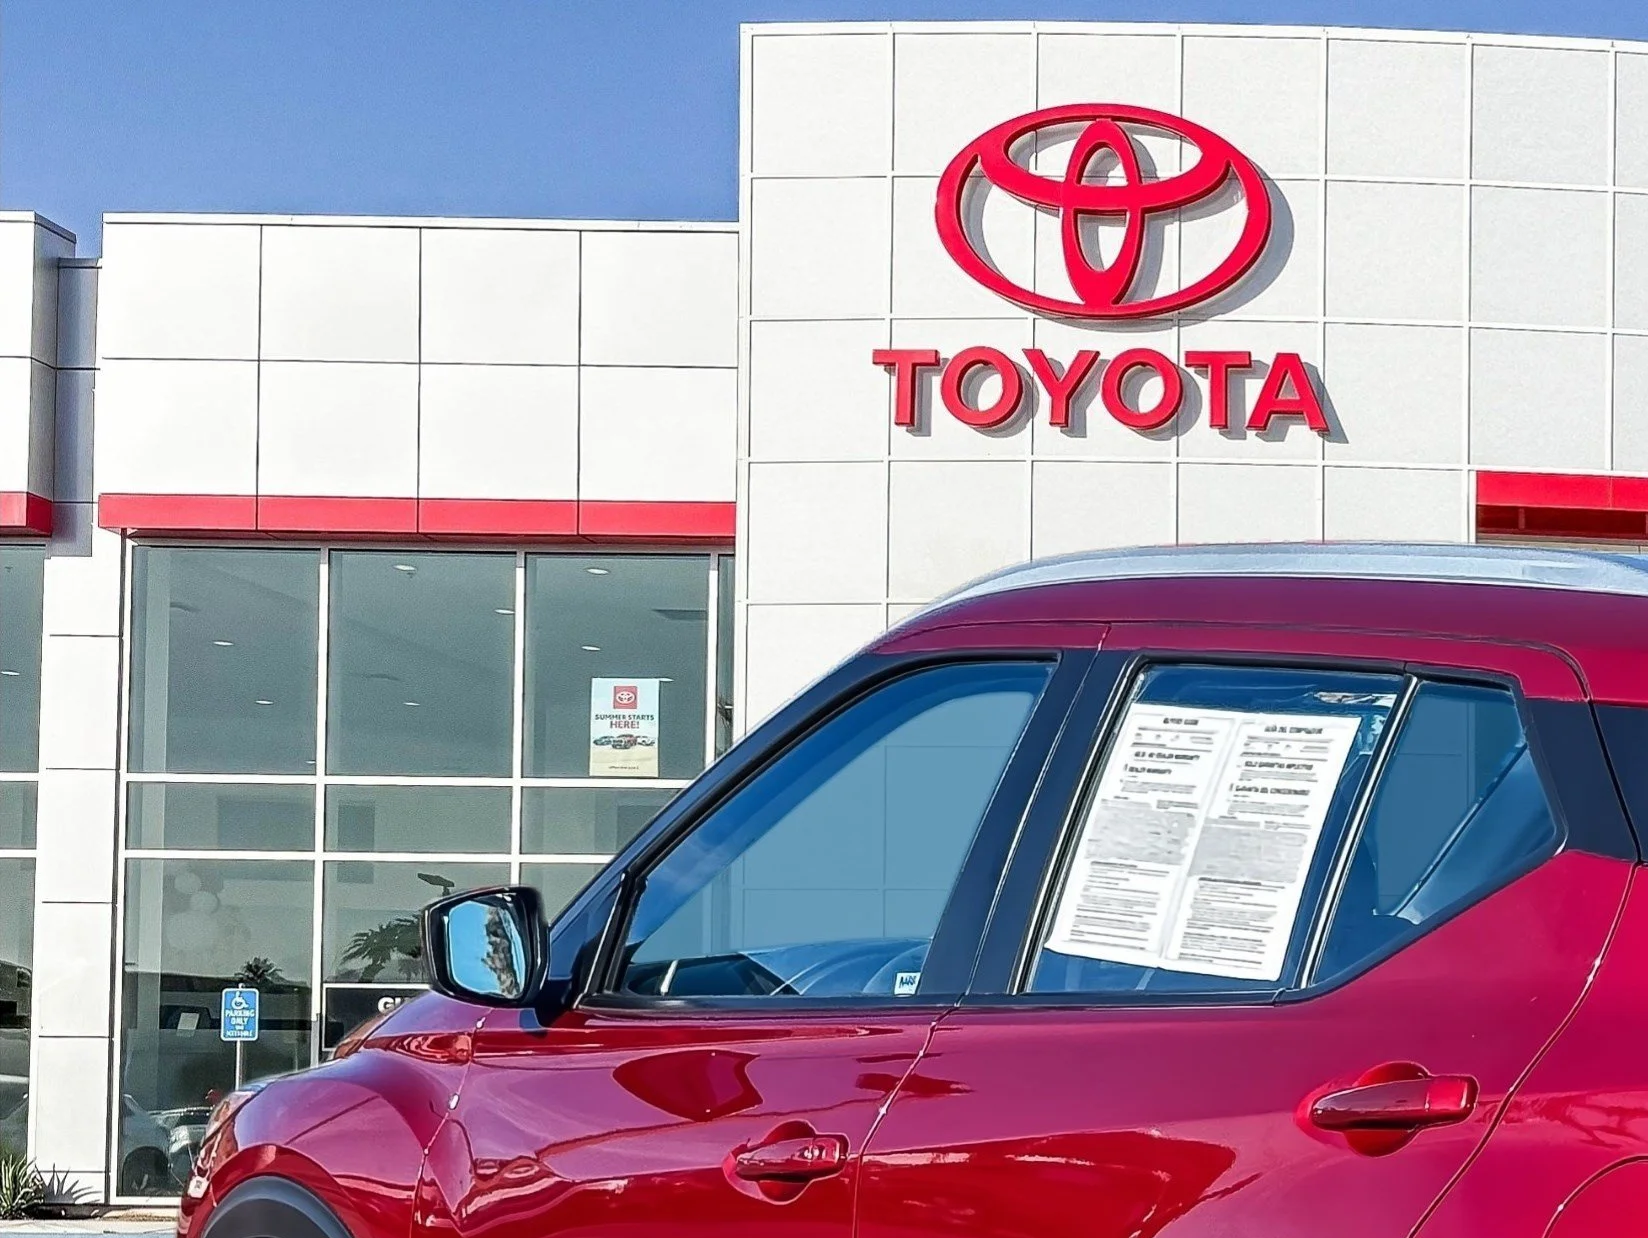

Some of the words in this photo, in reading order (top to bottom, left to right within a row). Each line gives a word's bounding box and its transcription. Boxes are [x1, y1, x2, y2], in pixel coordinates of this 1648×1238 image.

[872, 345, 1330, 434] TOYOTA
[610, 721, 639, 729] HERE!
[225, 1009, 255, 1017] PARKING
[230, 1017, 249, 1025] ONLY
